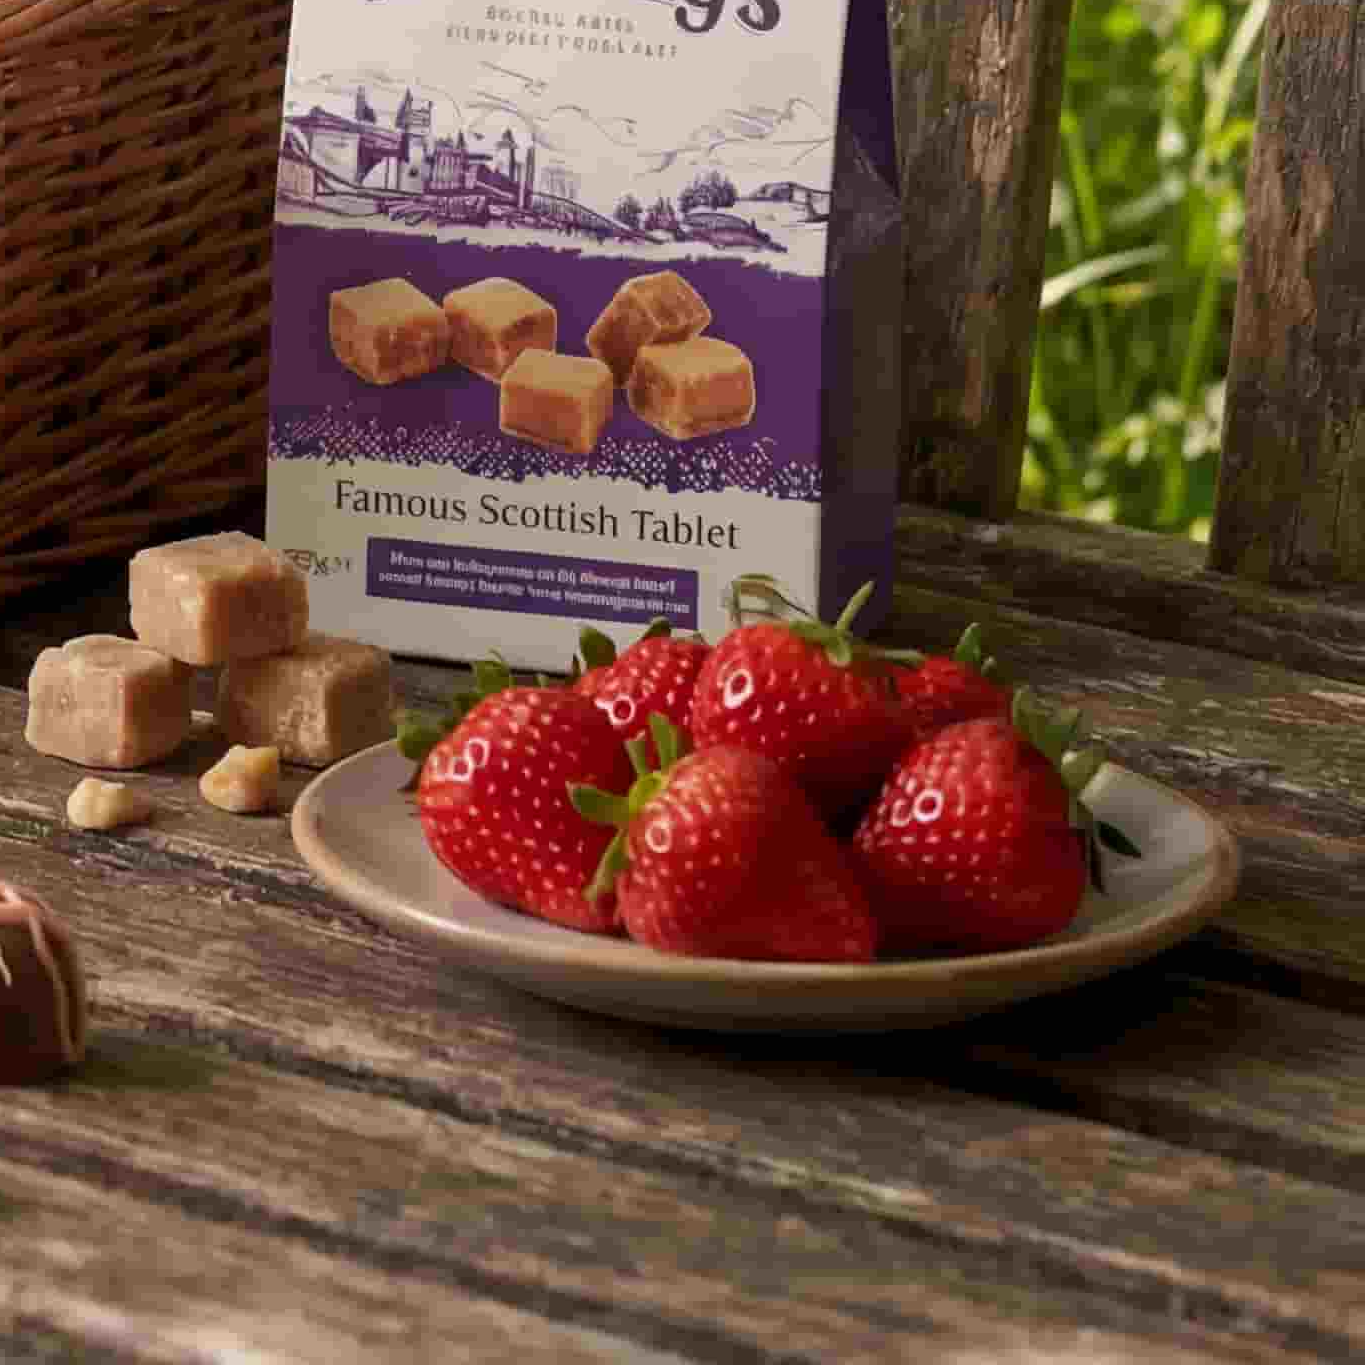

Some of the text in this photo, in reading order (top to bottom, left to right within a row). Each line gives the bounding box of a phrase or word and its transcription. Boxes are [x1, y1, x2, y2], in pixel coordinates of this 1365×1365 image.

[333, 479, 740, 550] Famous Scottish Tablet
